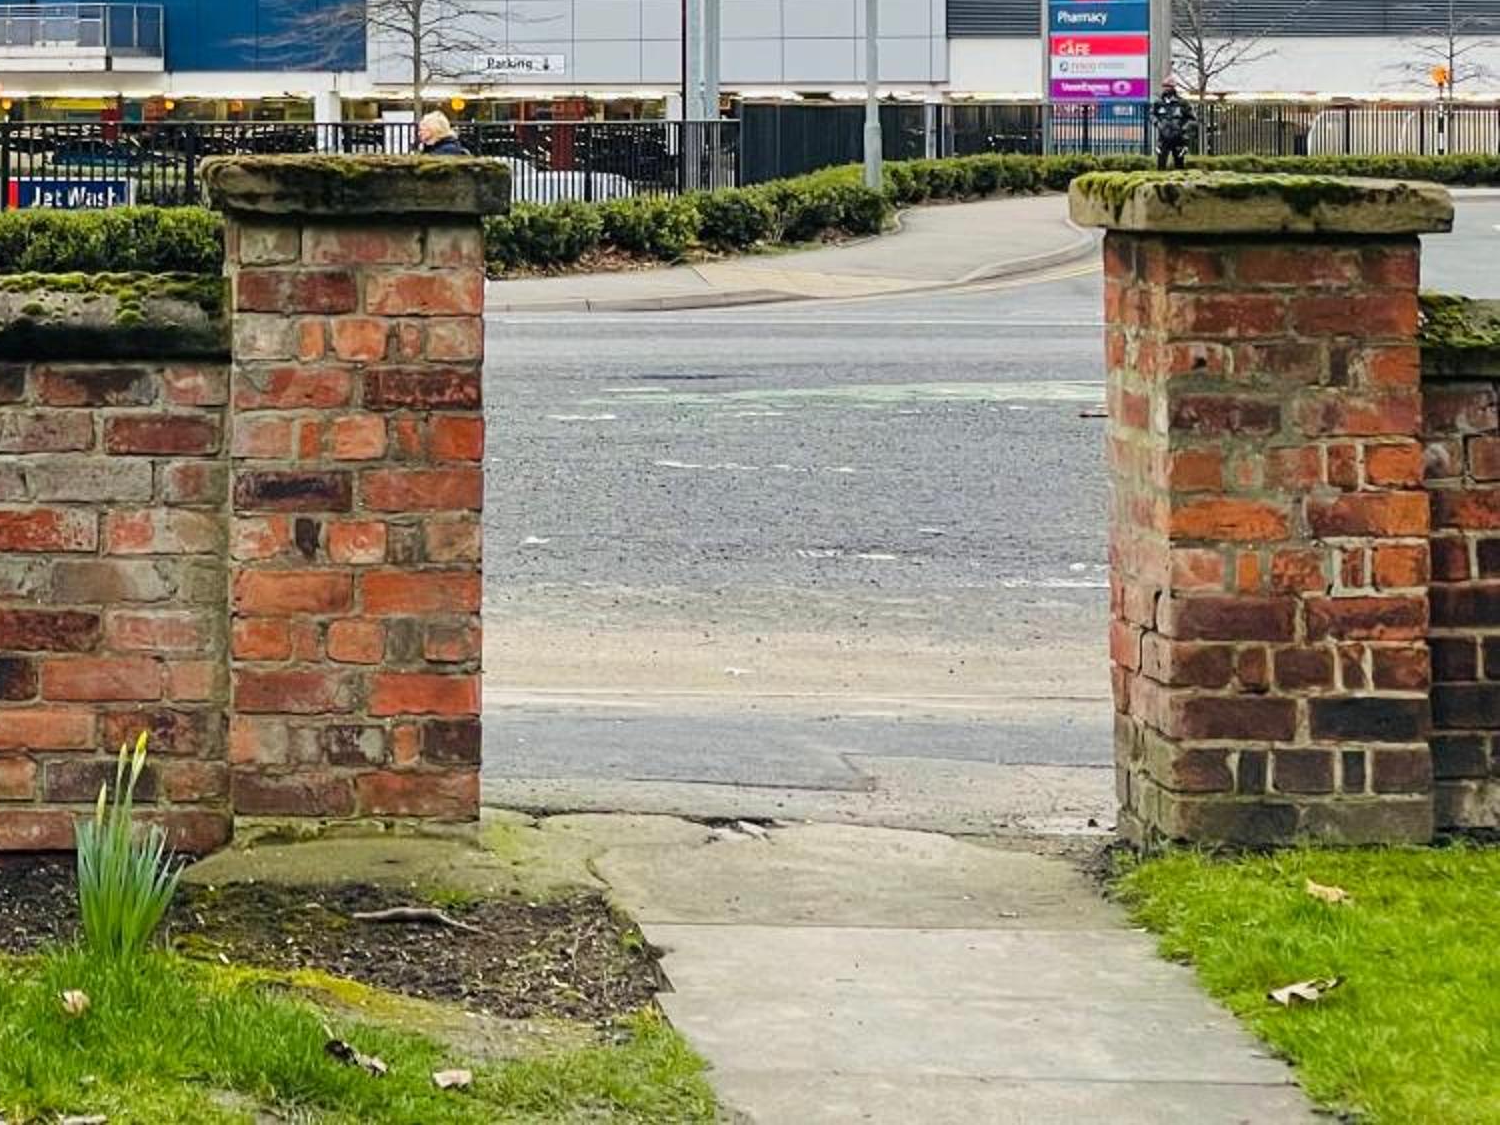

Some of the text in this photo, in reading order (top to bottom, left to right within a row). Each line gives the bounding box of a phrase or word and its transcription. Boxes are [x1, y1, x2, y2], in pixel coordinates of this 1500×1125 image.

[1057, 10, 1108, 26] Pharmacy
[486, 57, 533, 71] Parking
[31, 186, 63, 208] Jet
